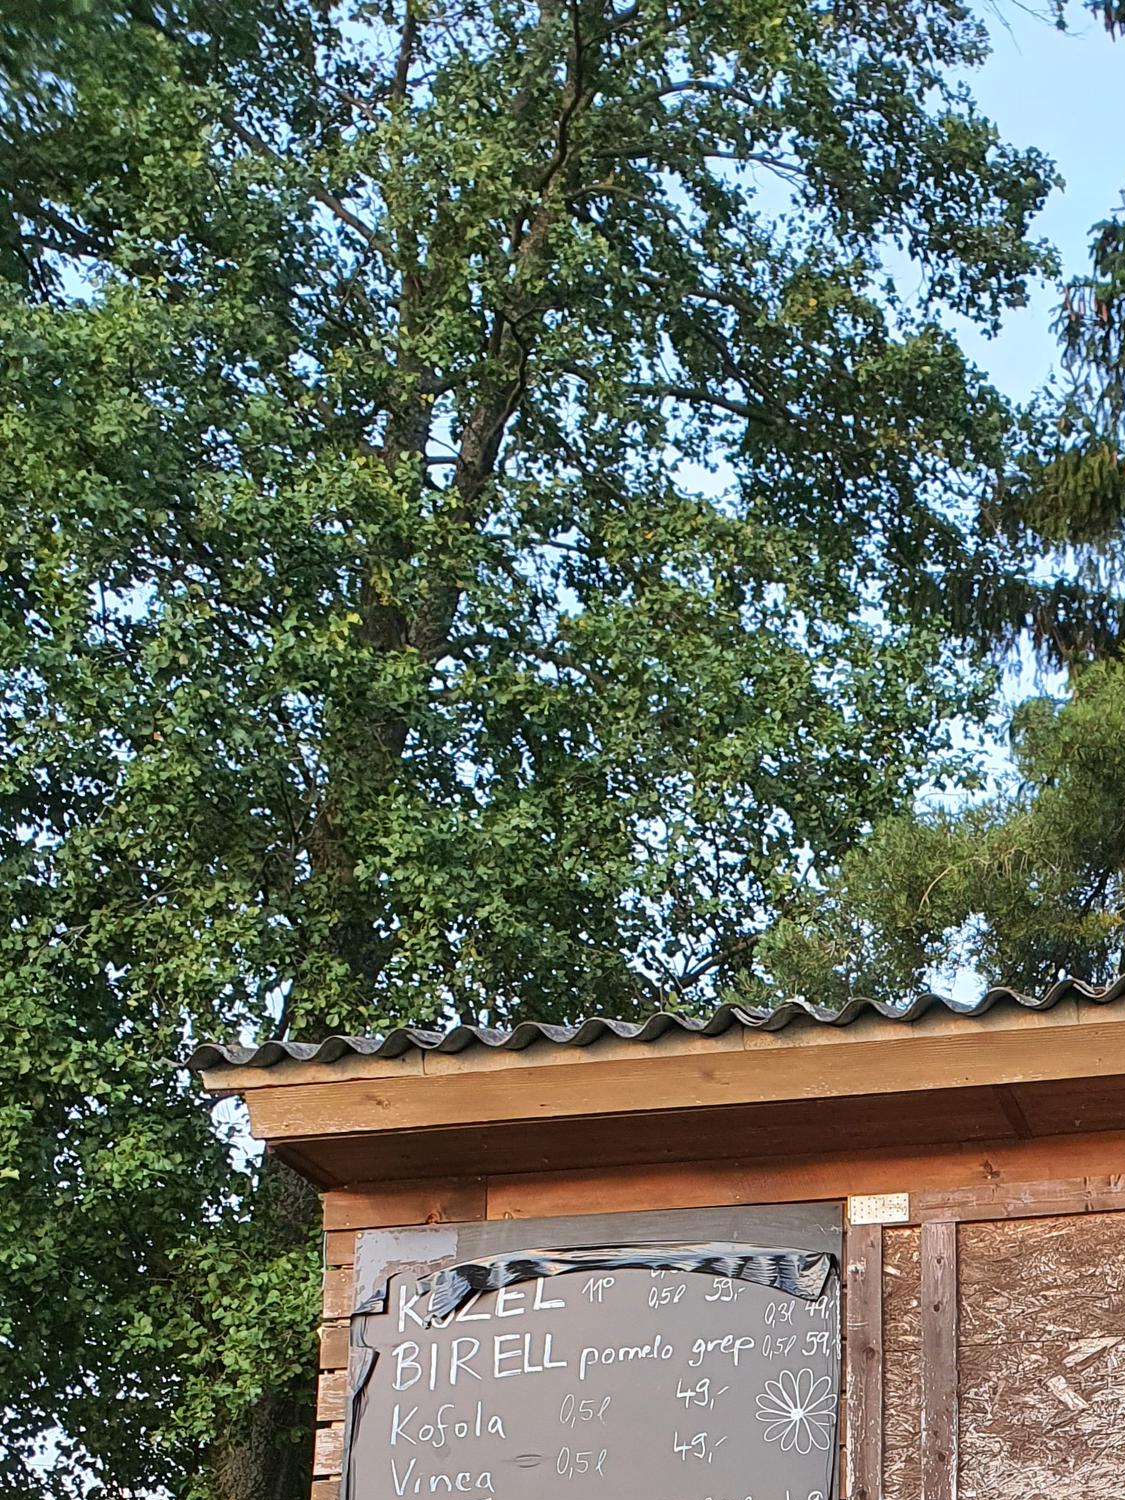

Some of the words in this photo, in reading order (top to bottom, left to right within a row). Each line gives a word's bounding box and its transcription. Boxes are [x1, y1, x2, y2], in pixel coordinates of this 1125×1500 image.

[391, 1332, 568, 1391] BIRELL
[579, 1335, 674, 1380] pomelo
[688, 1335, 755, 1367] grep
[390, 1401, 506, 1448] Kofola
[390, 1458, 495, 1496] Vinea
